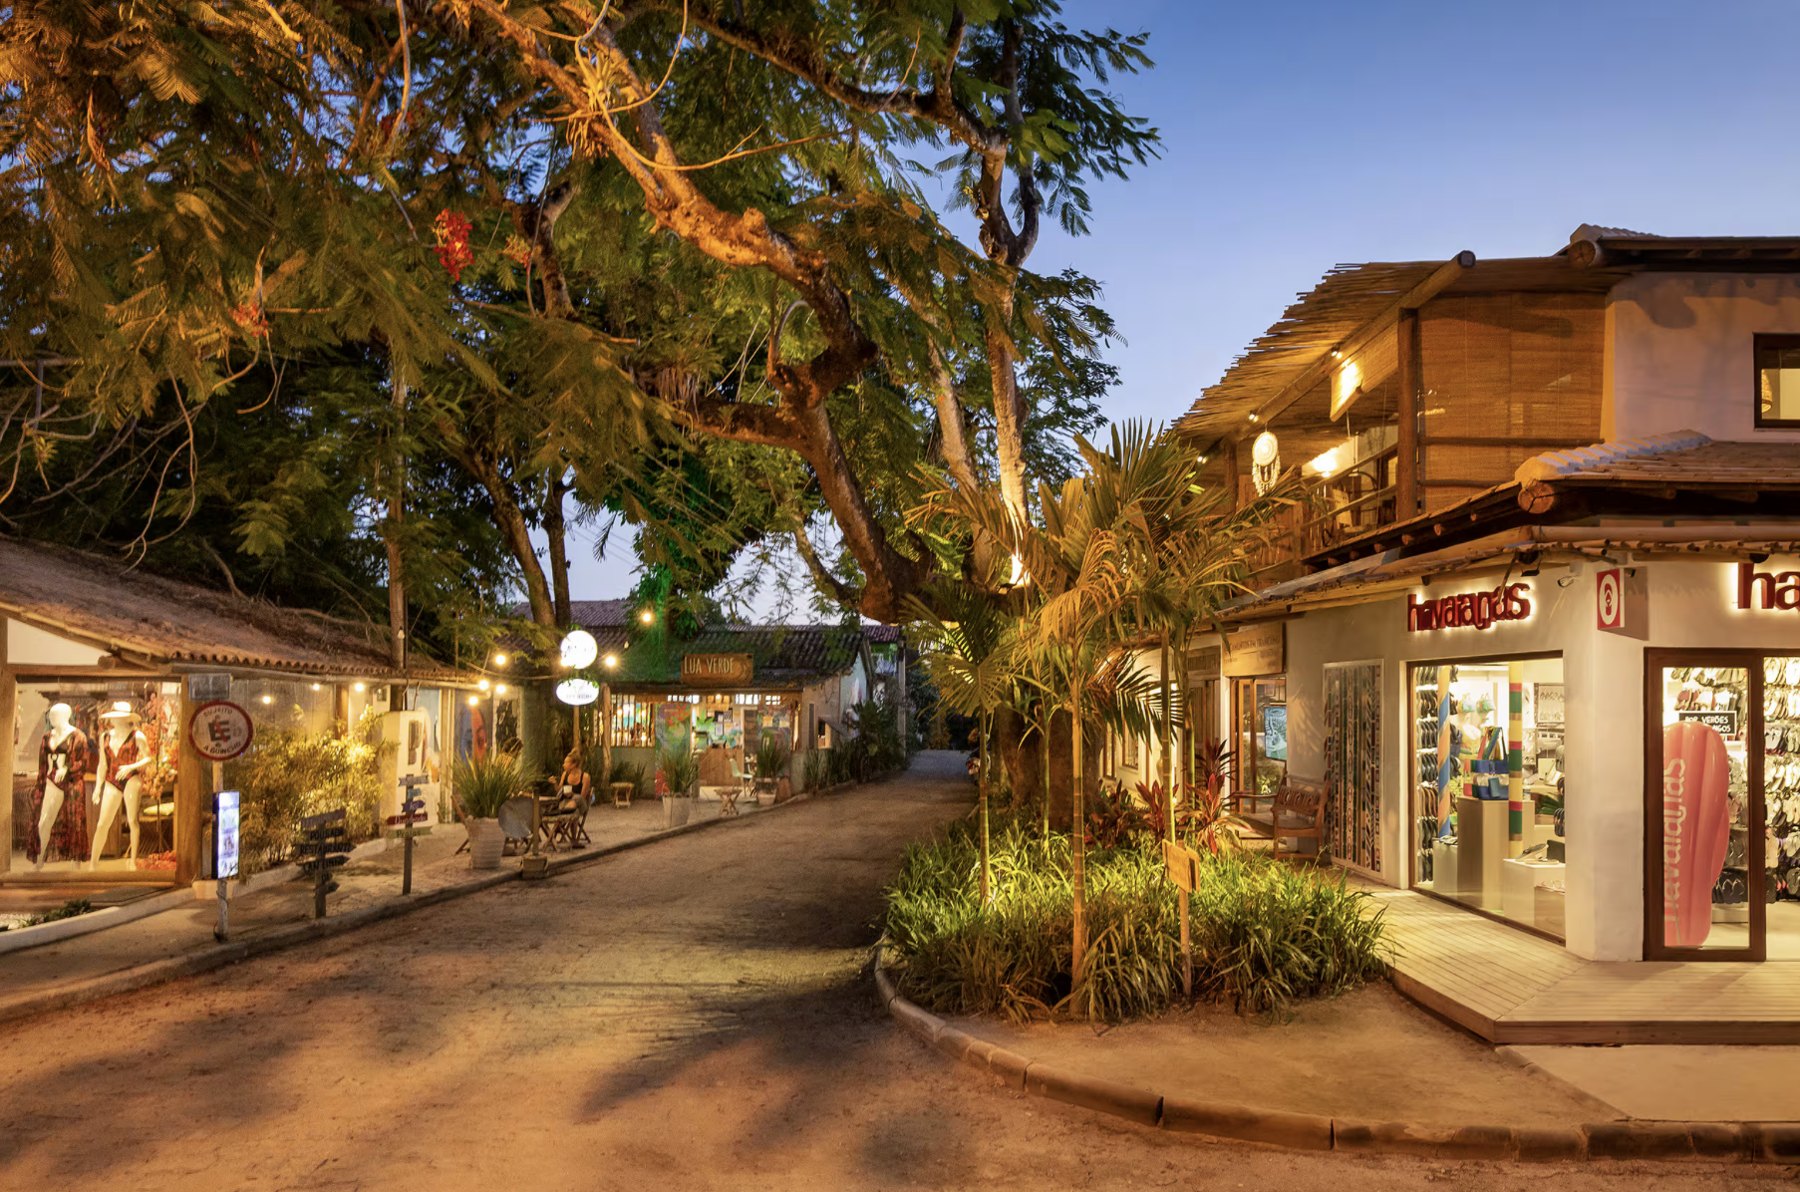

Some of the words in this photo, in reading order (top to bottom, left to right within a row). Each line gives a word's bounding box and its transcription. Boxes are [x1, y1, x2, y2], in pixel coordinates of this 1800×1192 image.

[1407, 582, 1531, 632] havaianas
[684, 656, 702, 674] LUA
[706, 657, 734, 674] VERDE
